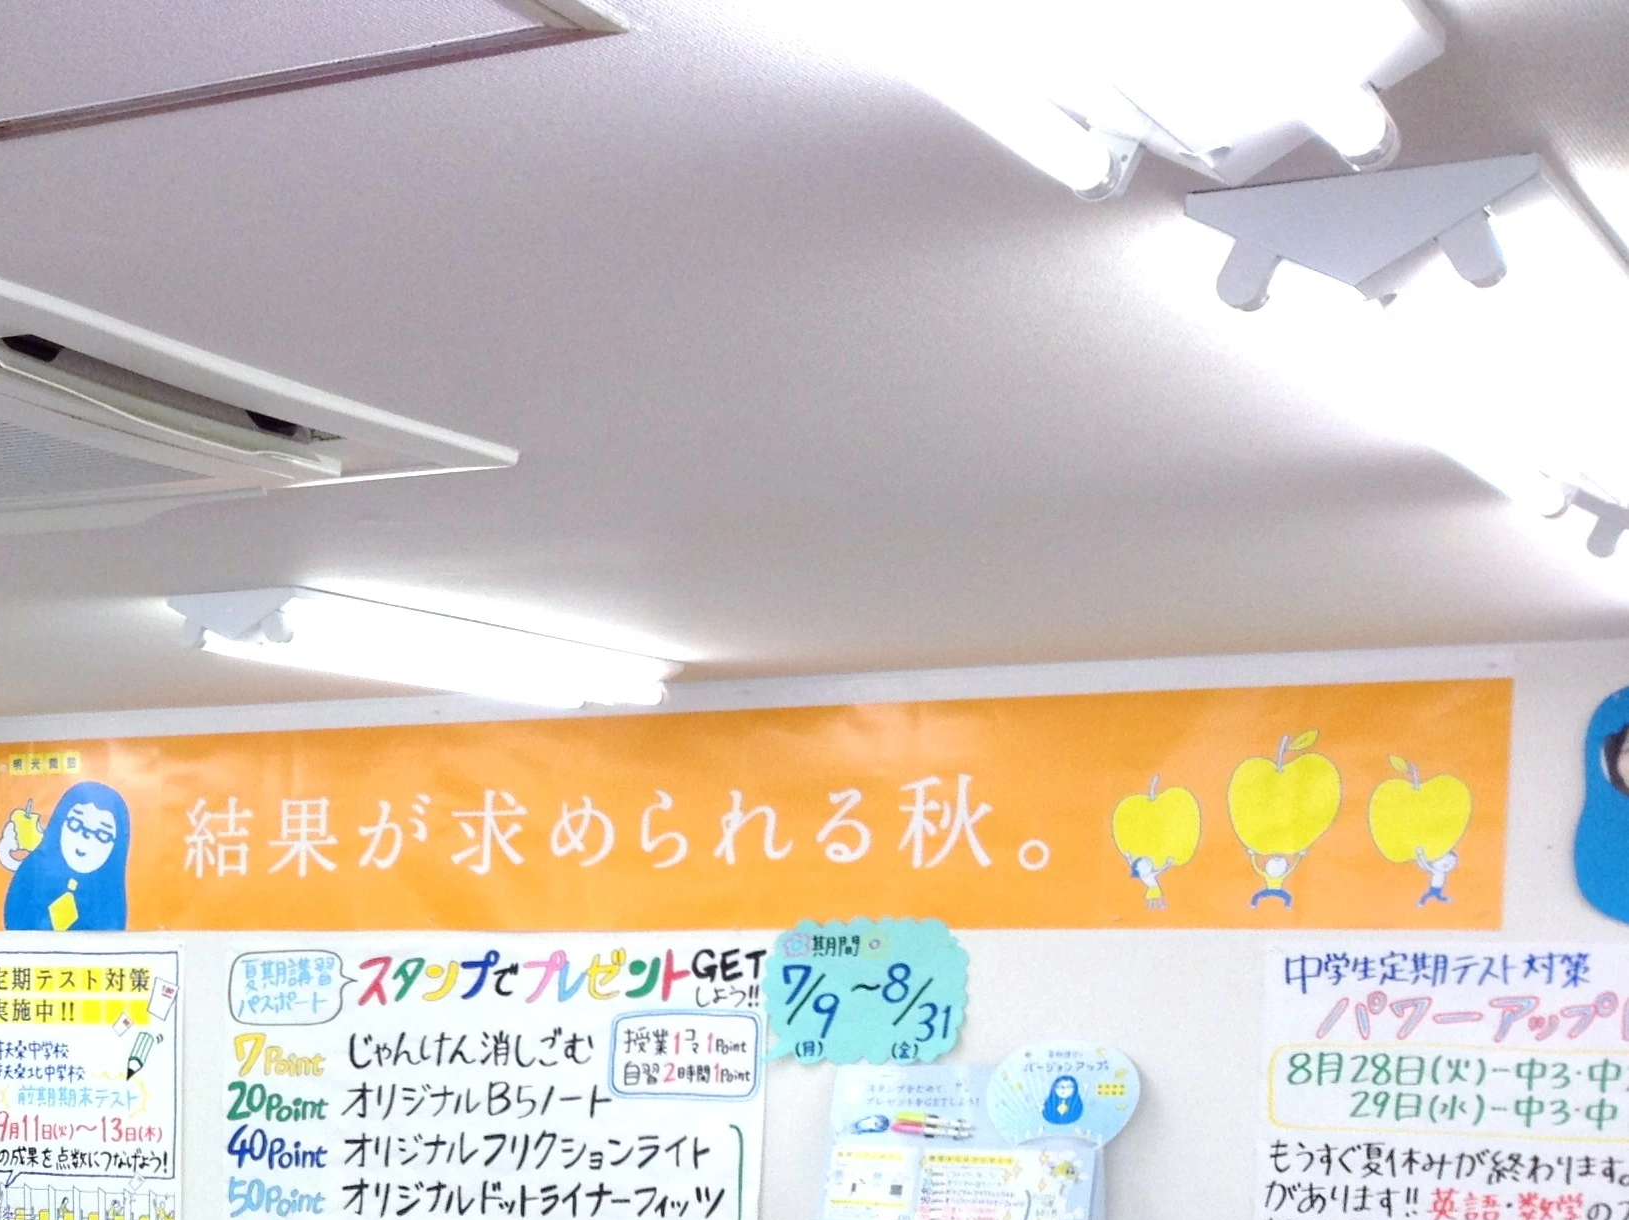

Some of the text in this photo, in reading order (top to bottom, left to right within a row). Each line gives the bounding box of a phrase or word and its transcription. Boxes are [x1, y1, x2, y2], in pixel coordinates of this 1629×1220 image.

[183, 774, 1051, 877] 結果が求められる秋。
[812, 935, 861, 957] 期間
[241, 957, 336, 992] 夏期講習
[357, 947, 767, 1006] スタンプでプレゼントGET
[1284, 951, 1591, 994] 中学生定期テスト対策
[237, 991, 329, 1018] パスポート
[696, 985, 761, 1008] しよう!!
[1316, 990, 1629, 1043] パワーアップ
[348, 1026, 594, 1070] じゃんけん消しごむ
[795, 1041, 824, 1058] (月)
[891, 1042, 919, 1060] (金)
[341, 1080, 613, 1120] オリジナルB5ノート
[343, 1130, 710, 1171] オリジナルフリクションライト
[341, 1178, 726, 1218] オリジナルドットライナーフィッツ
